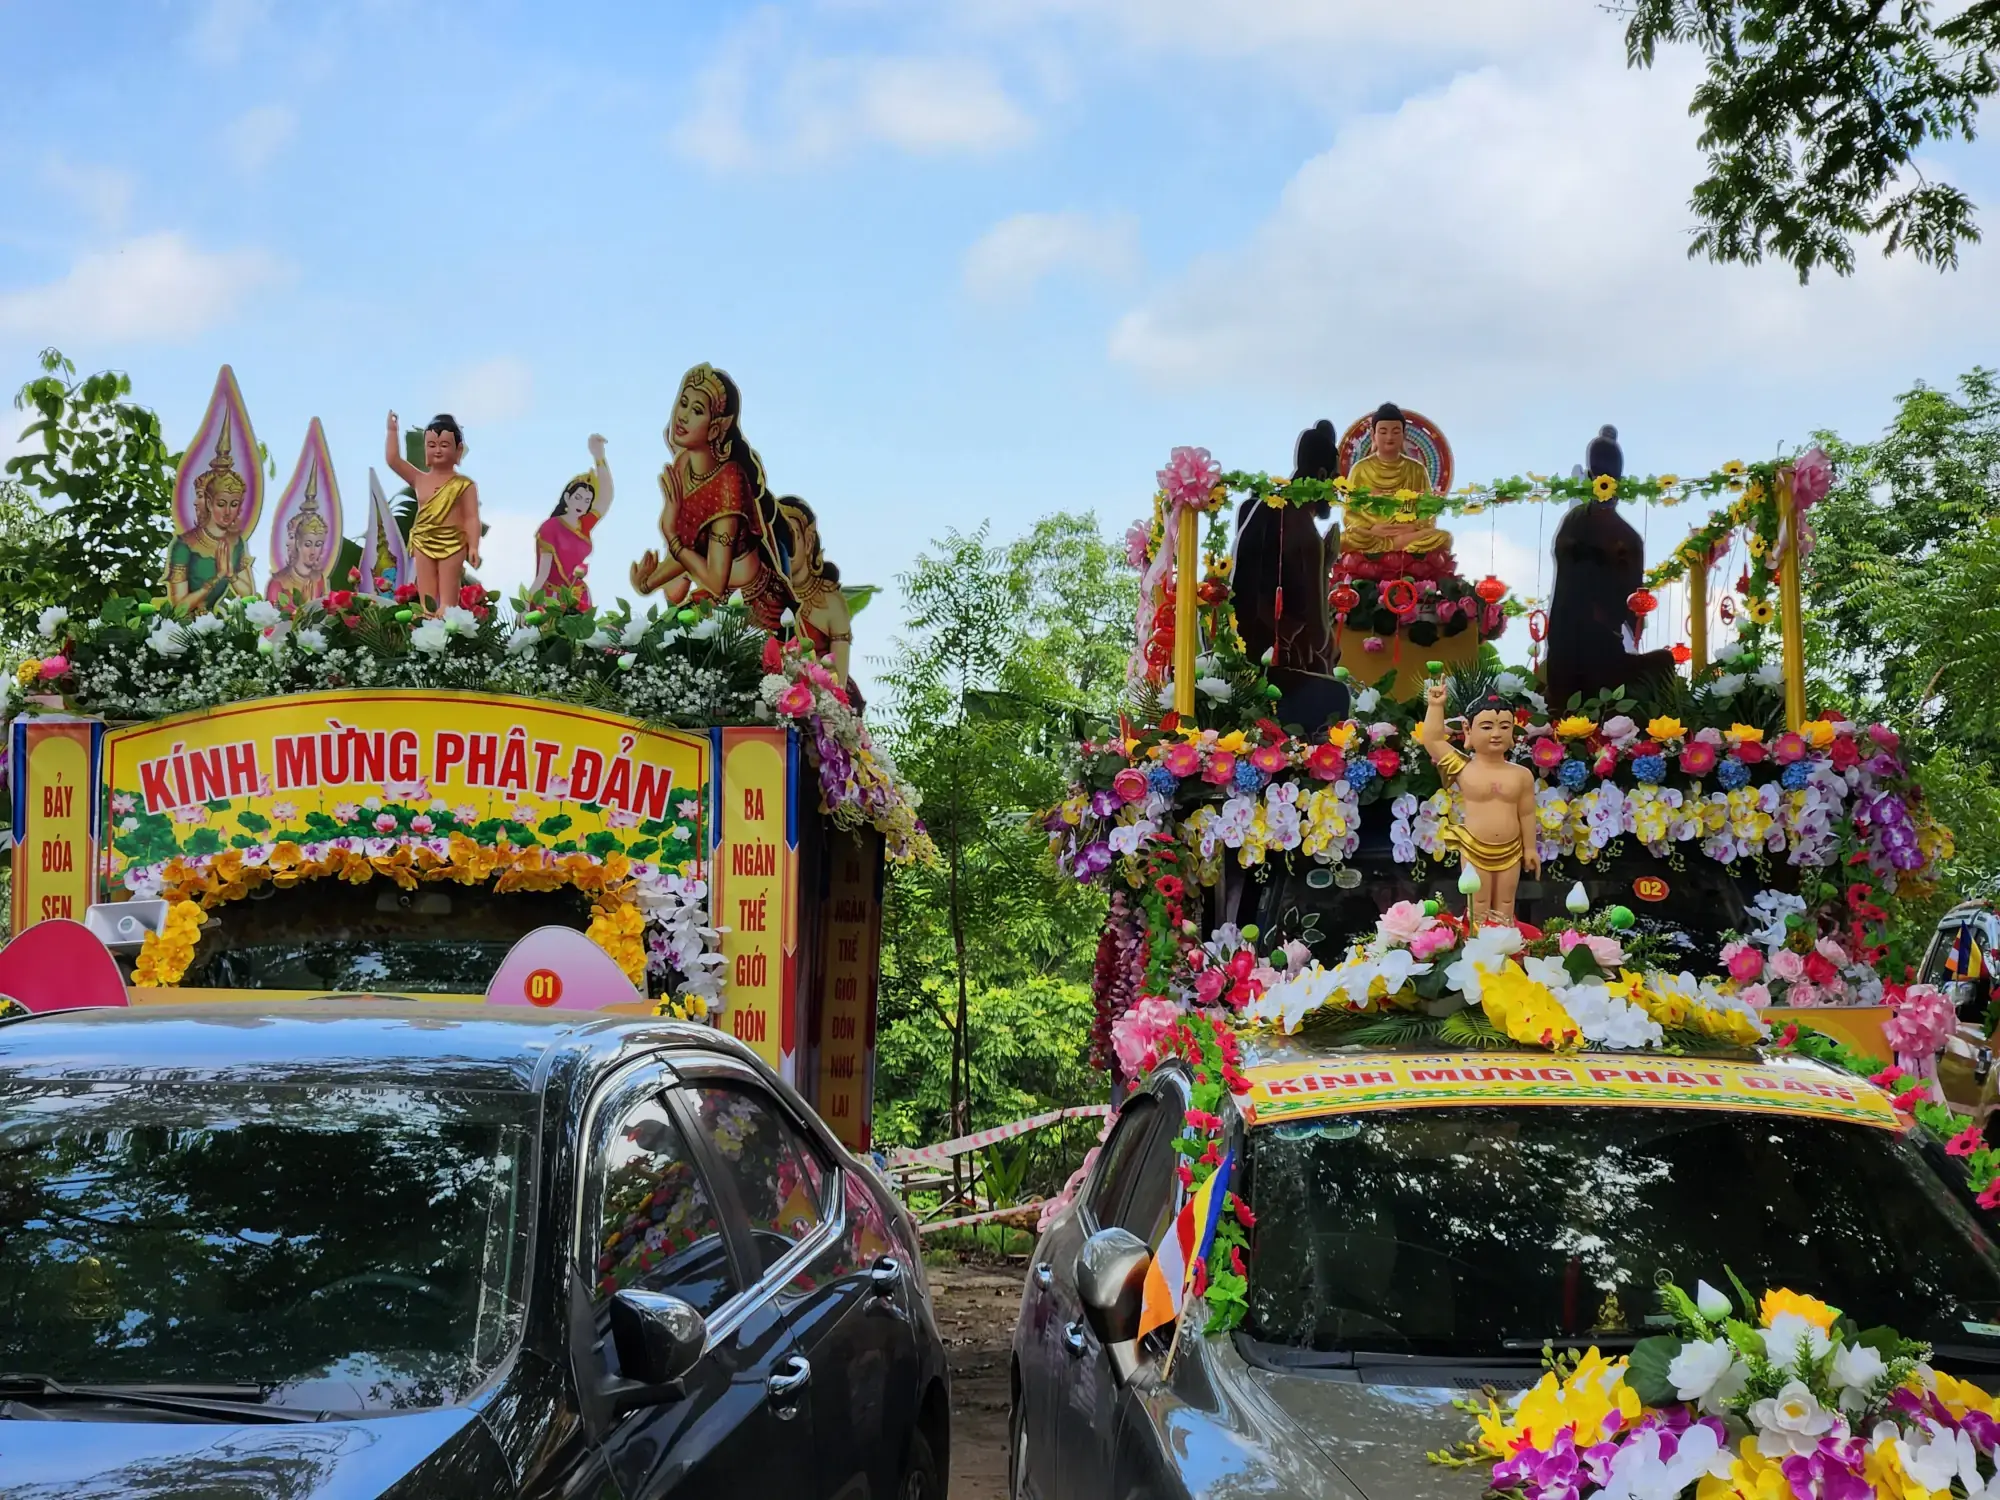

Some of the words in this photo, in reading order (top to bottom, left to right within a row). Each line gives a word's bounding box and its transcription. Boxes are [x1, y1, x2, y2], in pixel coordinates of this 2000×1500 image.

[140, 743, 259, 813] KÍNH
[275, 720, 418, 789] MỪNG
[434, 727, 560, 801] PHẬT
[568, 736, 673, 820] ĐẢN
[43, 772, 73, 818] BẢY
[744, 788, 765, 821] BA
[42, 834, 73, 873] ĐÓA
[732, 836, 776, 877] NGÀN
[1640, 881, 1662, 896] 02
[739, 888, 769, 932] THẾ
[736, 945, 767, 987] GIỚI
[532, 975, 554, 999] 01
[834, 972, 857, 1002] GIỚI
[734, 1003, 766, 1042] ĐÓN
[832, 1012, 855, 1040] ĐÓN
[830, 1054, 855, 1079] NHƯ
[1267, 1071, 1394, 1095] KÍNH
[1410, 1065, 1574, 1082] MỪNG
[1588, 1068, 1723, 1089] PHẬT
[832, 1095, 849, 1117] LAI
